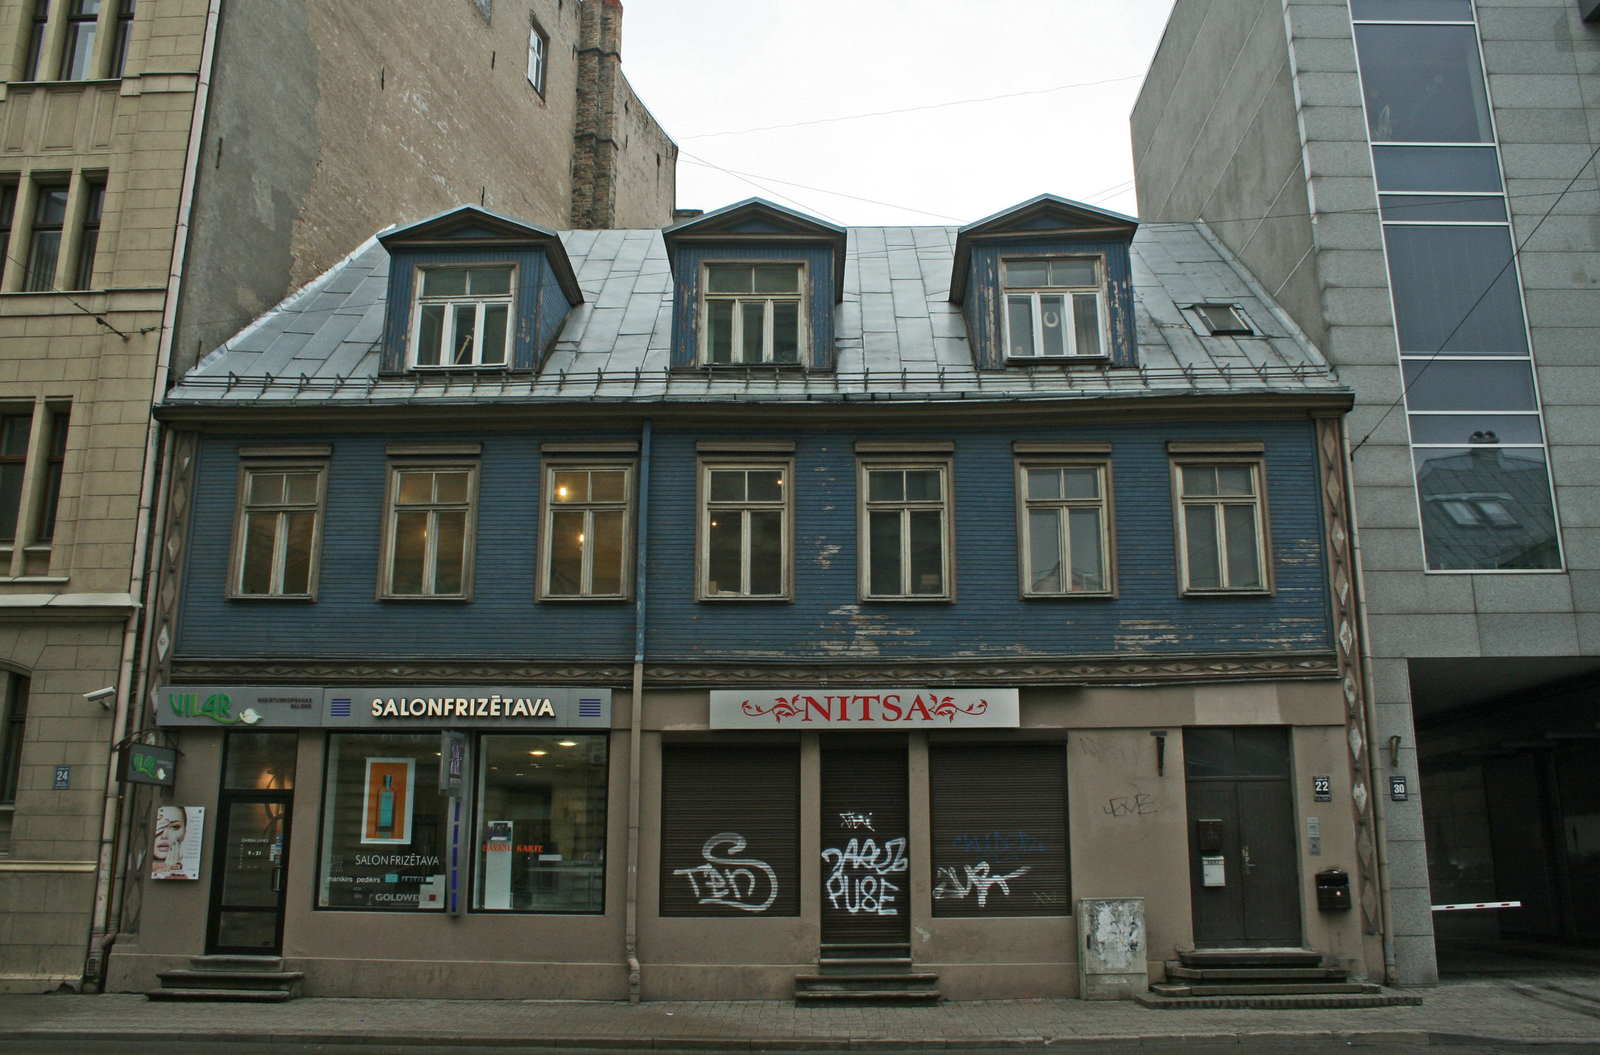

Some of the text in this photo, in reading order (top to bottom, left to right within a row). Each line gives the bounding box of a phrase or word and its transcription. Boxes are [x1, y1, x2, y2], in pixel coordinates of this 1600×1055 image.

[168, 693, 232, 719] VILAR
[371, 695, 556, 717] SALONFRIZĒTAVA
[801, 694, 935, 722] NITSA
[56, 770, 68, 781] 24
[1315, 781, 1329, 791] 22
[1393, 784, 1405, 793] 30
[516, 845, 544, 853] KARTE
[375, 893, 420, 902] GOLDWE
